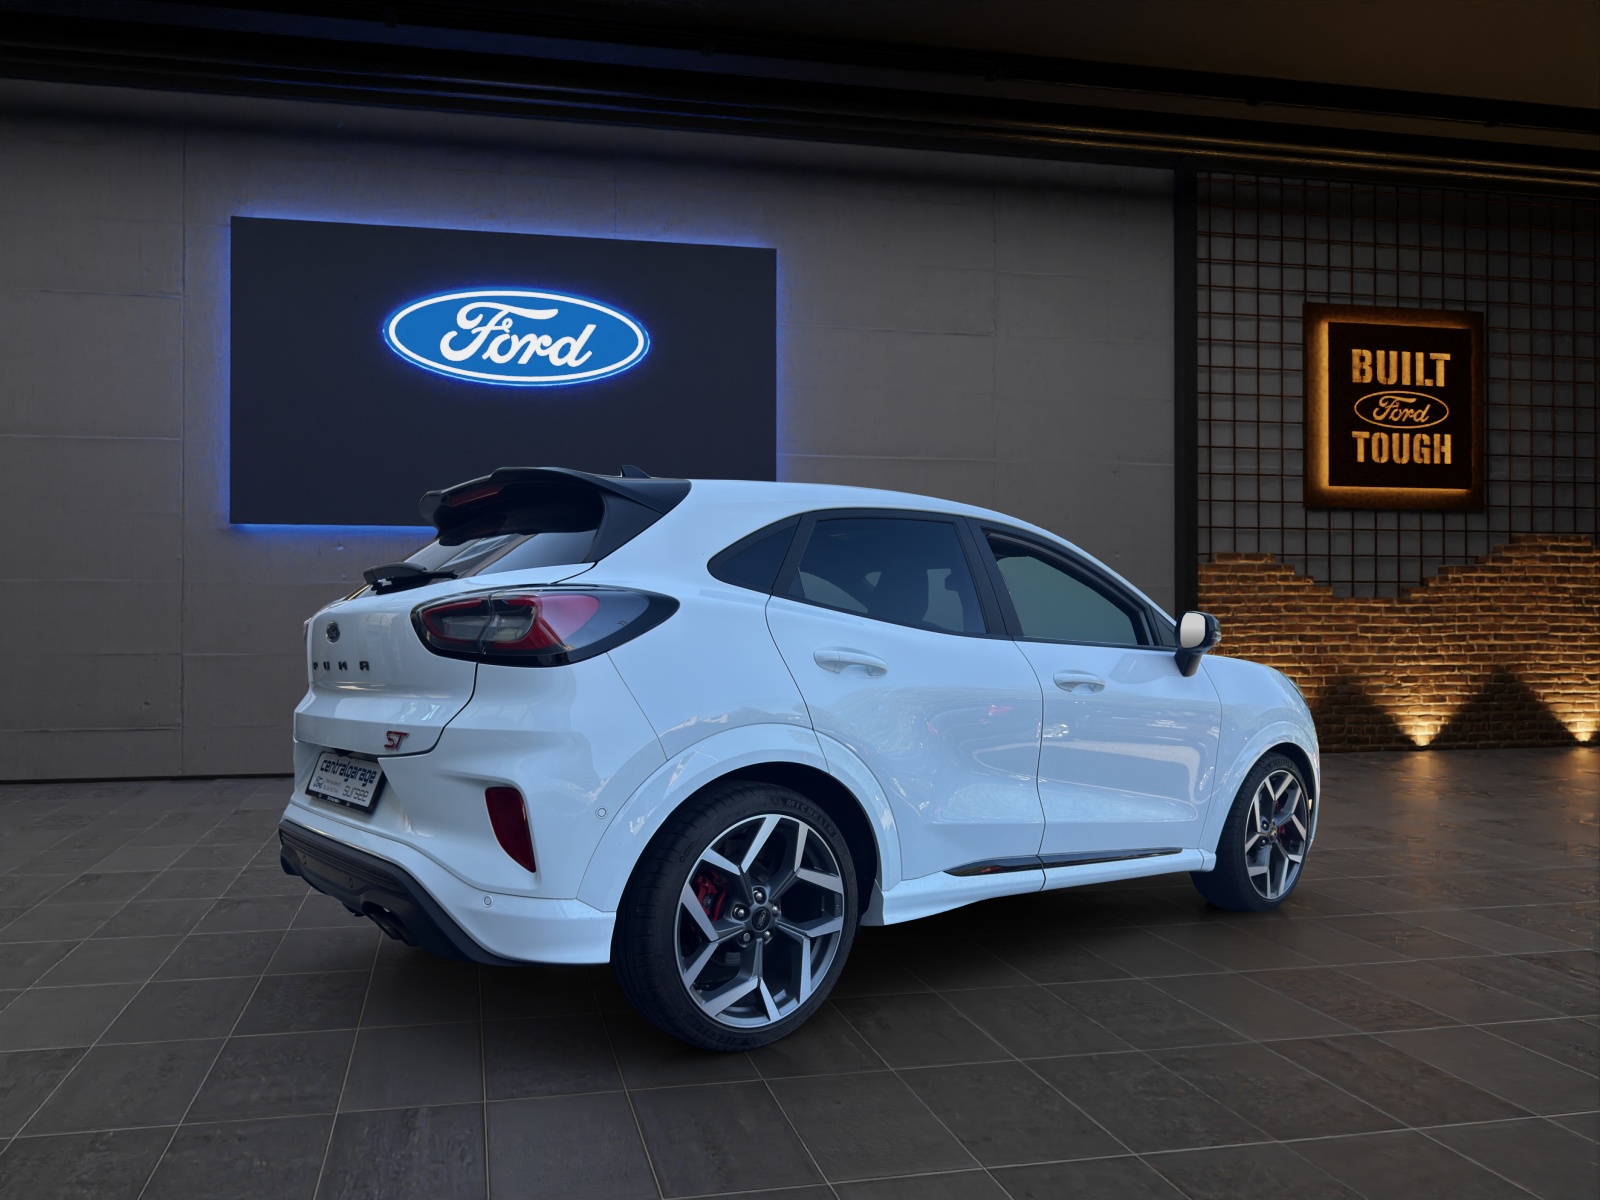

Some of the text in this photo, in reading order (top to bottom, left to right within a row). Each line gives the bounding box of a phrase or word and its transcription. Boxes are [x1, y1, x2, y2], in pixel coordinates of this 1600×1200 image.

[440, 301, 597, 367] Ford
[1351, 348, 1451, 387] BUILT
[1372, 395, 1431, 423] Ford
[1351, 430, 1452, 465] TOUGH
[313, 661, 370, 671] PUMA
[384, 730, 410, 750] ST
[320, 759, 378, 787] centralgarage
[342, 785, 370, 802] sursee
[785, 798, 836, 836] MICHELIN
